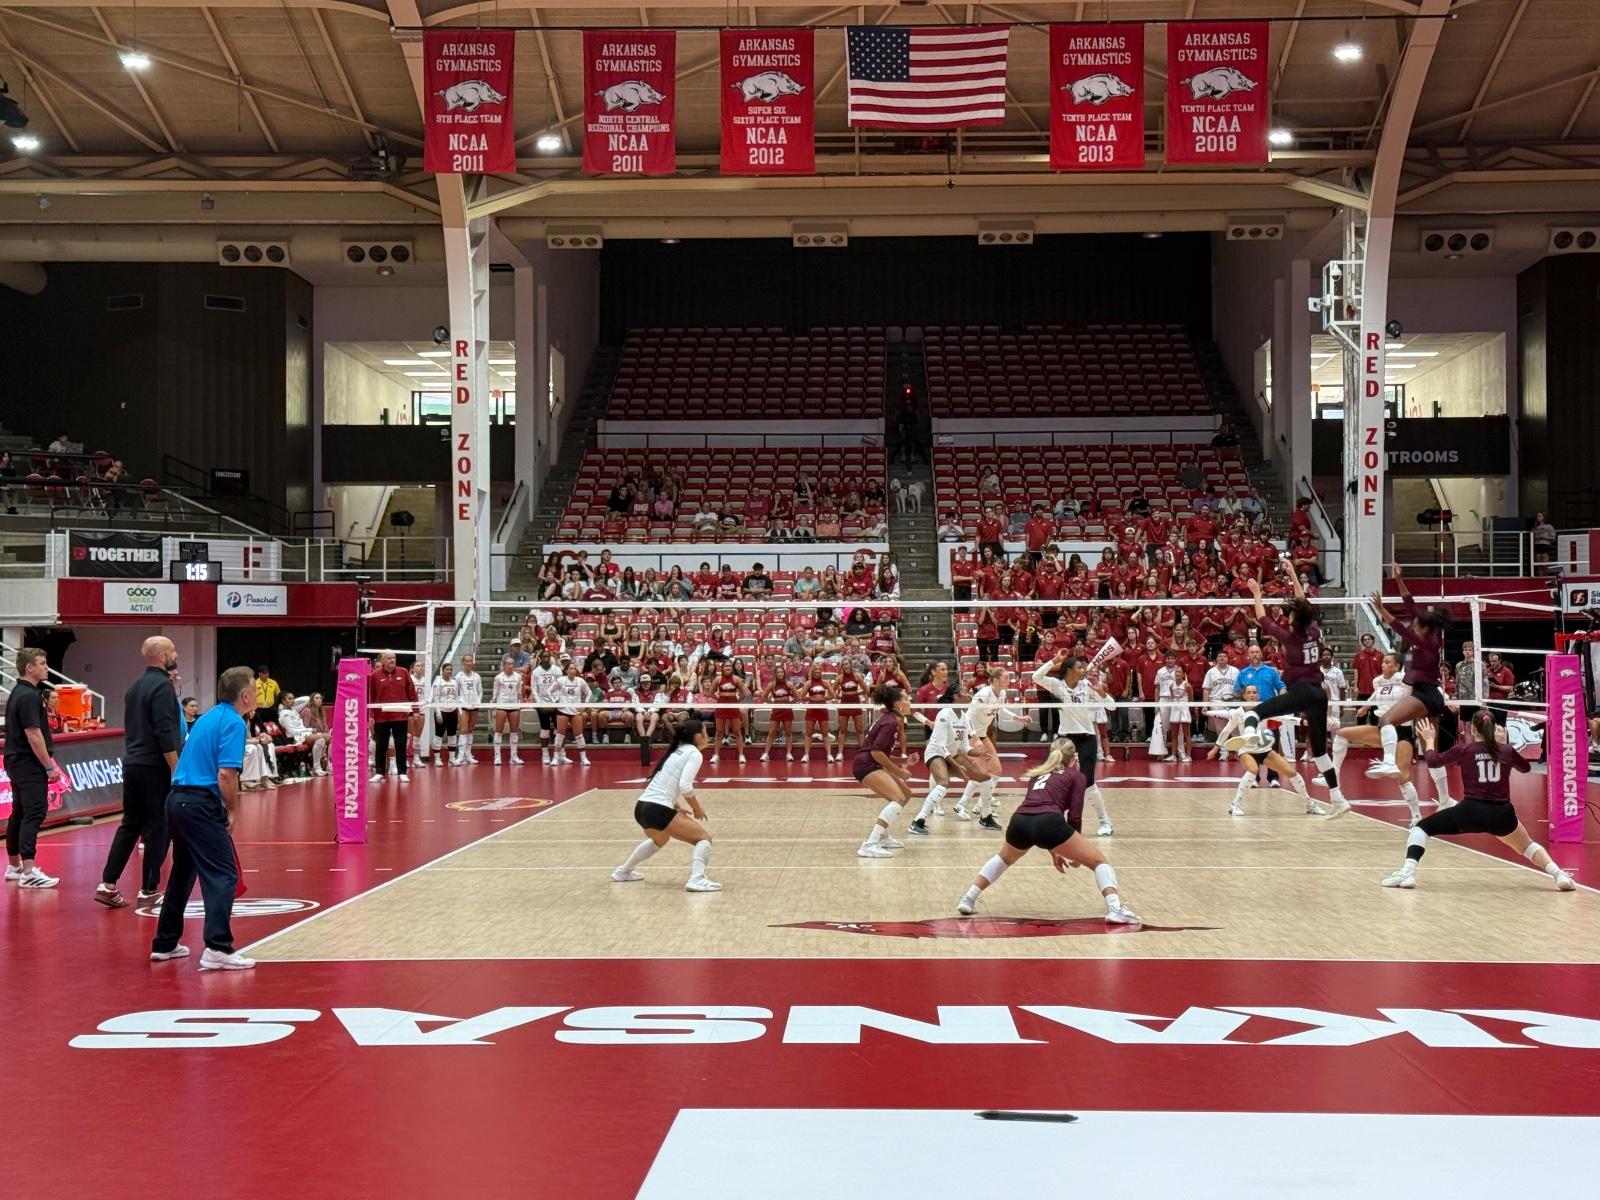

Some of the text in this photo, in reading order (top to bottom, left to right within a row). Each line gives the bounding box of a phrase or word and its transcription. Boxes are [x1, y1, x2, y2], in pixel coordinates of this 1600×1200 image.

[739, 38, 795, 51] ARKANSAS
[1069, 36, 1126, 50] ARKANSAS
[1185, 32, 1251, 46] ARKANSAS
[442, 43, 496, 56] ARKANSAS
[602, 43, 656, 56] ARKANSAS
[1177, 48, 1258, 62] GYMNASTICS
[436, 59, 502, 72] GYMNASTICS
[595, 59, 662, 73] GYMNASTICS
[732, 54, 801, 67] GYMNASTICS
[1062, 52, 1132, 66] GYMNASTICS
[747, 106, 786, 115] SUPER SIX
[1180, 103, 1255, 113] TENTH PLACE TEAM
[454, 114, 478, 124] PLACE
[480, 114, 502, 124] TEAM
[598, 115, 660, 124] NORTH CENTRAL
[732, 115, 802, 124] SIXTH PLACE TEAM
[1061, 113, 1132, 122] TENTH PLACE TEAM
[1191, 115, 1242, 134] NCAA
[587, 123, 670, 133] REGIONAL CHAMPIONS
[1075, 124, 1118, 142] NCAA
[448, 133, 489, 151] NCAA
[608, 133, 649, 152] NCAA
[745, 127, 788, 145] NCAA
[1195, 134, 1237, 153] 2018
[749, 147, 785, 165] 2012
[1078, 144, 1114, 163] 2013
[452, 154, 484, 172] 2011
[612, 154, 644, 173] 2011
[455, 339, 472, 521] RED ZONE
[1363, 332, 1380, 516] RED ZONE
[1389, 450, 1459, 464] TROOMS
[89, 547, 160, 562] TOGETHER
[185, 563, 208, 581] 1:15
[126, 587, 157, 597] GOGO
[1092, 644, 1115, 666] HOGS
[1303, 646, 1319, 664] 19
[954, 730, 965, 741] 30
[344, 698, 360, 819] RAZORBACKS
[1561, 693, 1579, 818] RAZORBACKS
[1476, 760, 1501, 783] 10
[1032, 773, 1052, 791] 2
